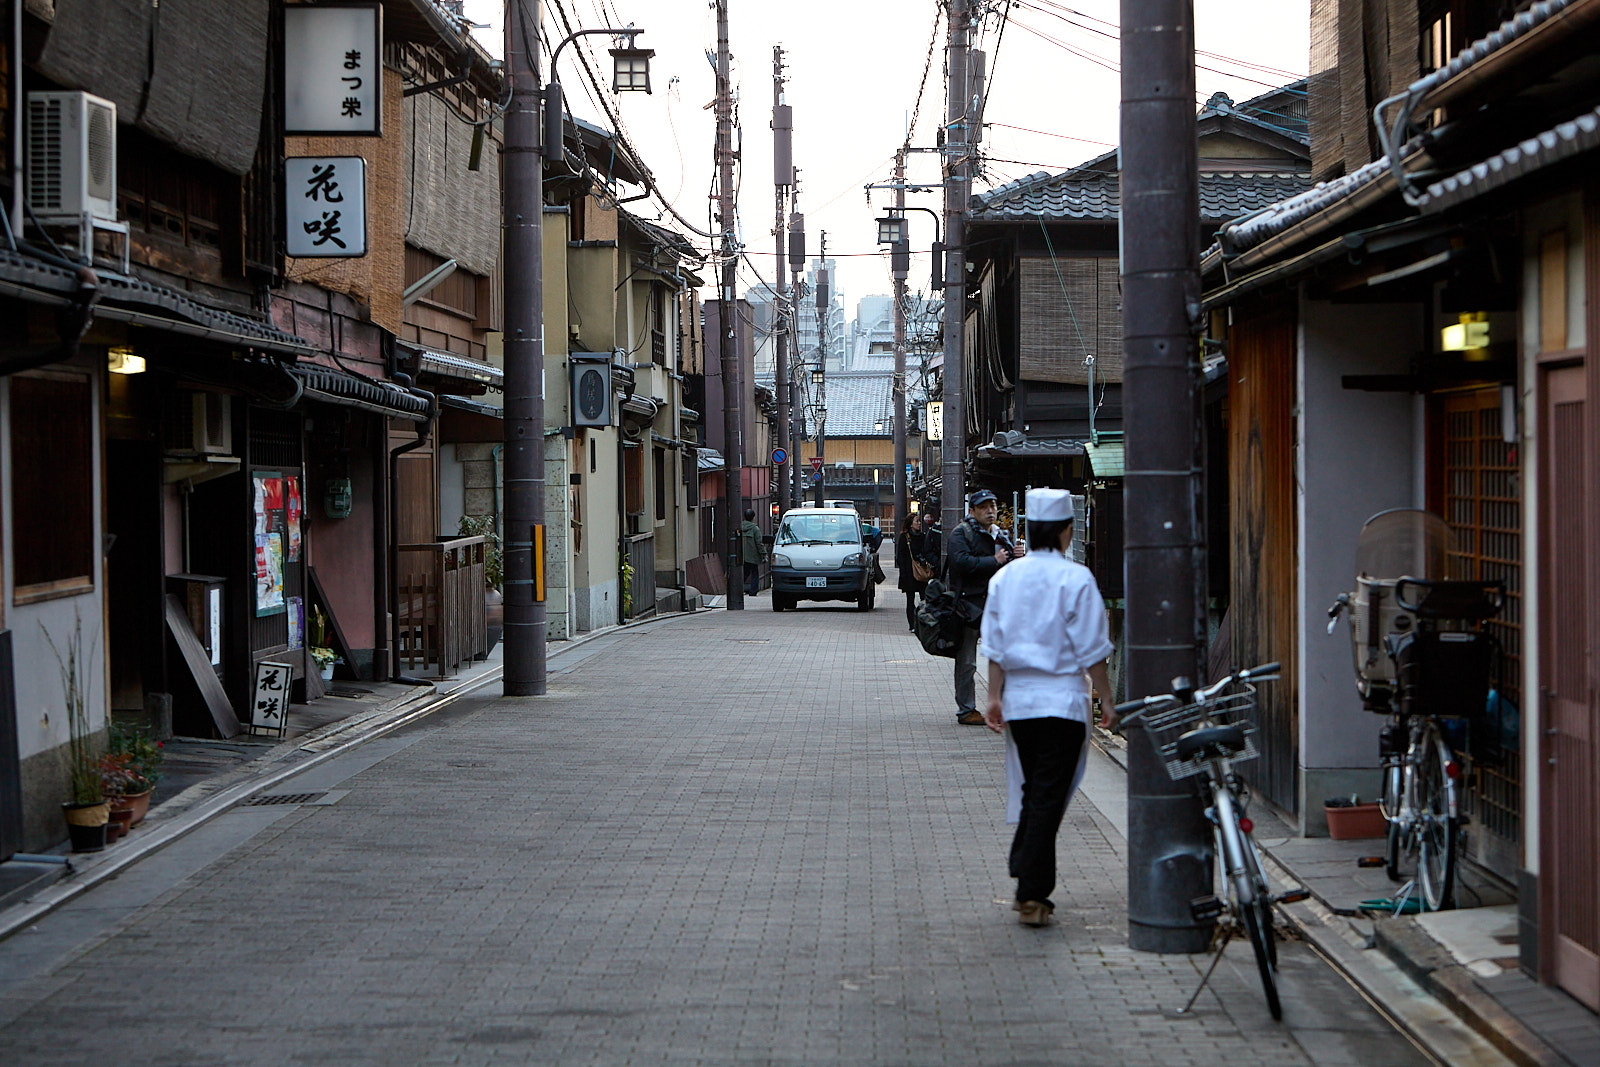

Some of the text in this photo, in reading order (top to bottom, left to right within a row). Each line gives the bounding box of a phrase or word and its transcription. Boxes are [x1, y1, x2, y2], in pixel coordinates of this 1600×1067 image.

[341, 49, 362, 118] まつ栄
[303, 164, 347, 249] 花咲
[257, 669, 283, 719] 花咲
